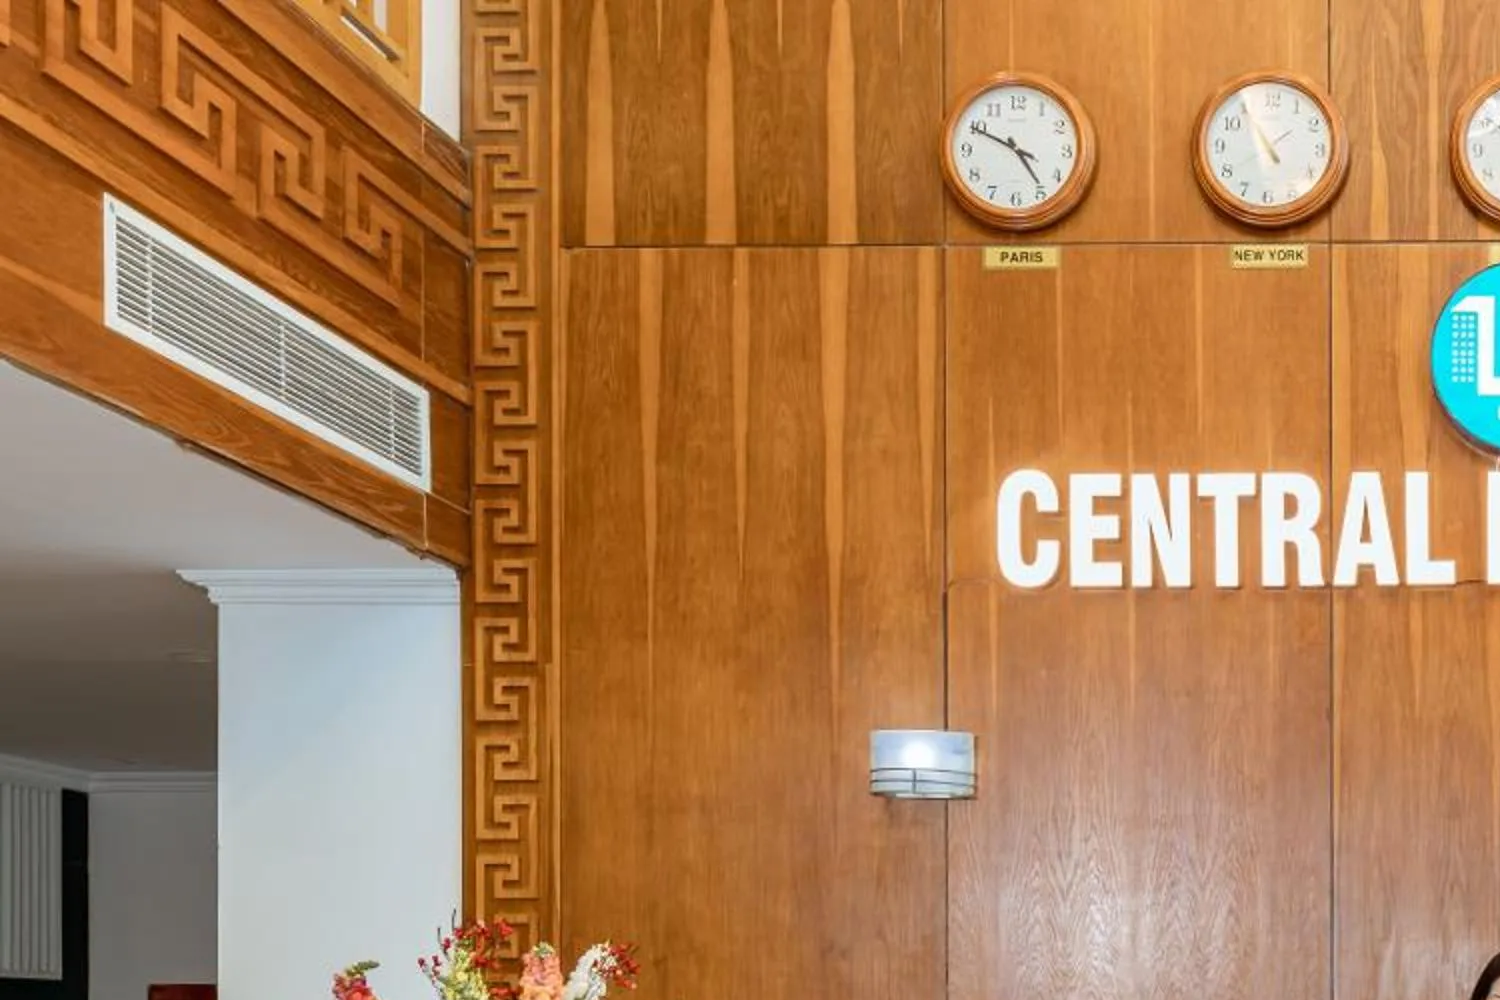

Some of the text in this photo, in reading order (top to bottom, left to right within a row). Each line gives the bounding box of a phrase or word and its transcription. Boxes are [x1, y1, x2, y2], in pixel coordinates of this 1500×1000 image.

[987, 103, 1001, 118] 11
[1010, 95, 1027, 111] 12
[1039, 101, 1045, 117] 1
[1293, 99, 1300, 115] 1
[970, 120, 987, 135] 10
[1054, 119, 1066, 135] 2
[1223, 116, 1241, 132] 10
[1309, 117, 1320, 133] 2
[961, 142, 973, 158] 9
[1062, 143, 1073, 160] 3
[1215, 137, 1226, 155] 9
[1315, 142, 1326, 158] 3
[968, 166, 981, 181] 8
[1053, 167, 1062, 183] 4
[1221, 163, 1234, 179] 8
[987, 185, 997, 201] 7
[1035, 185, 1047, 201] 5
[1240, 181, 1250, 198] 7
[1010, 191, 1023, 207] 6
[1262, 190, 1274, 206] 6
[1000, 251, 1043, 263] PARIS
[1234, 249, 1303, 261] NEW YORK
[997, 470, 1456, 588] CENTRAL
